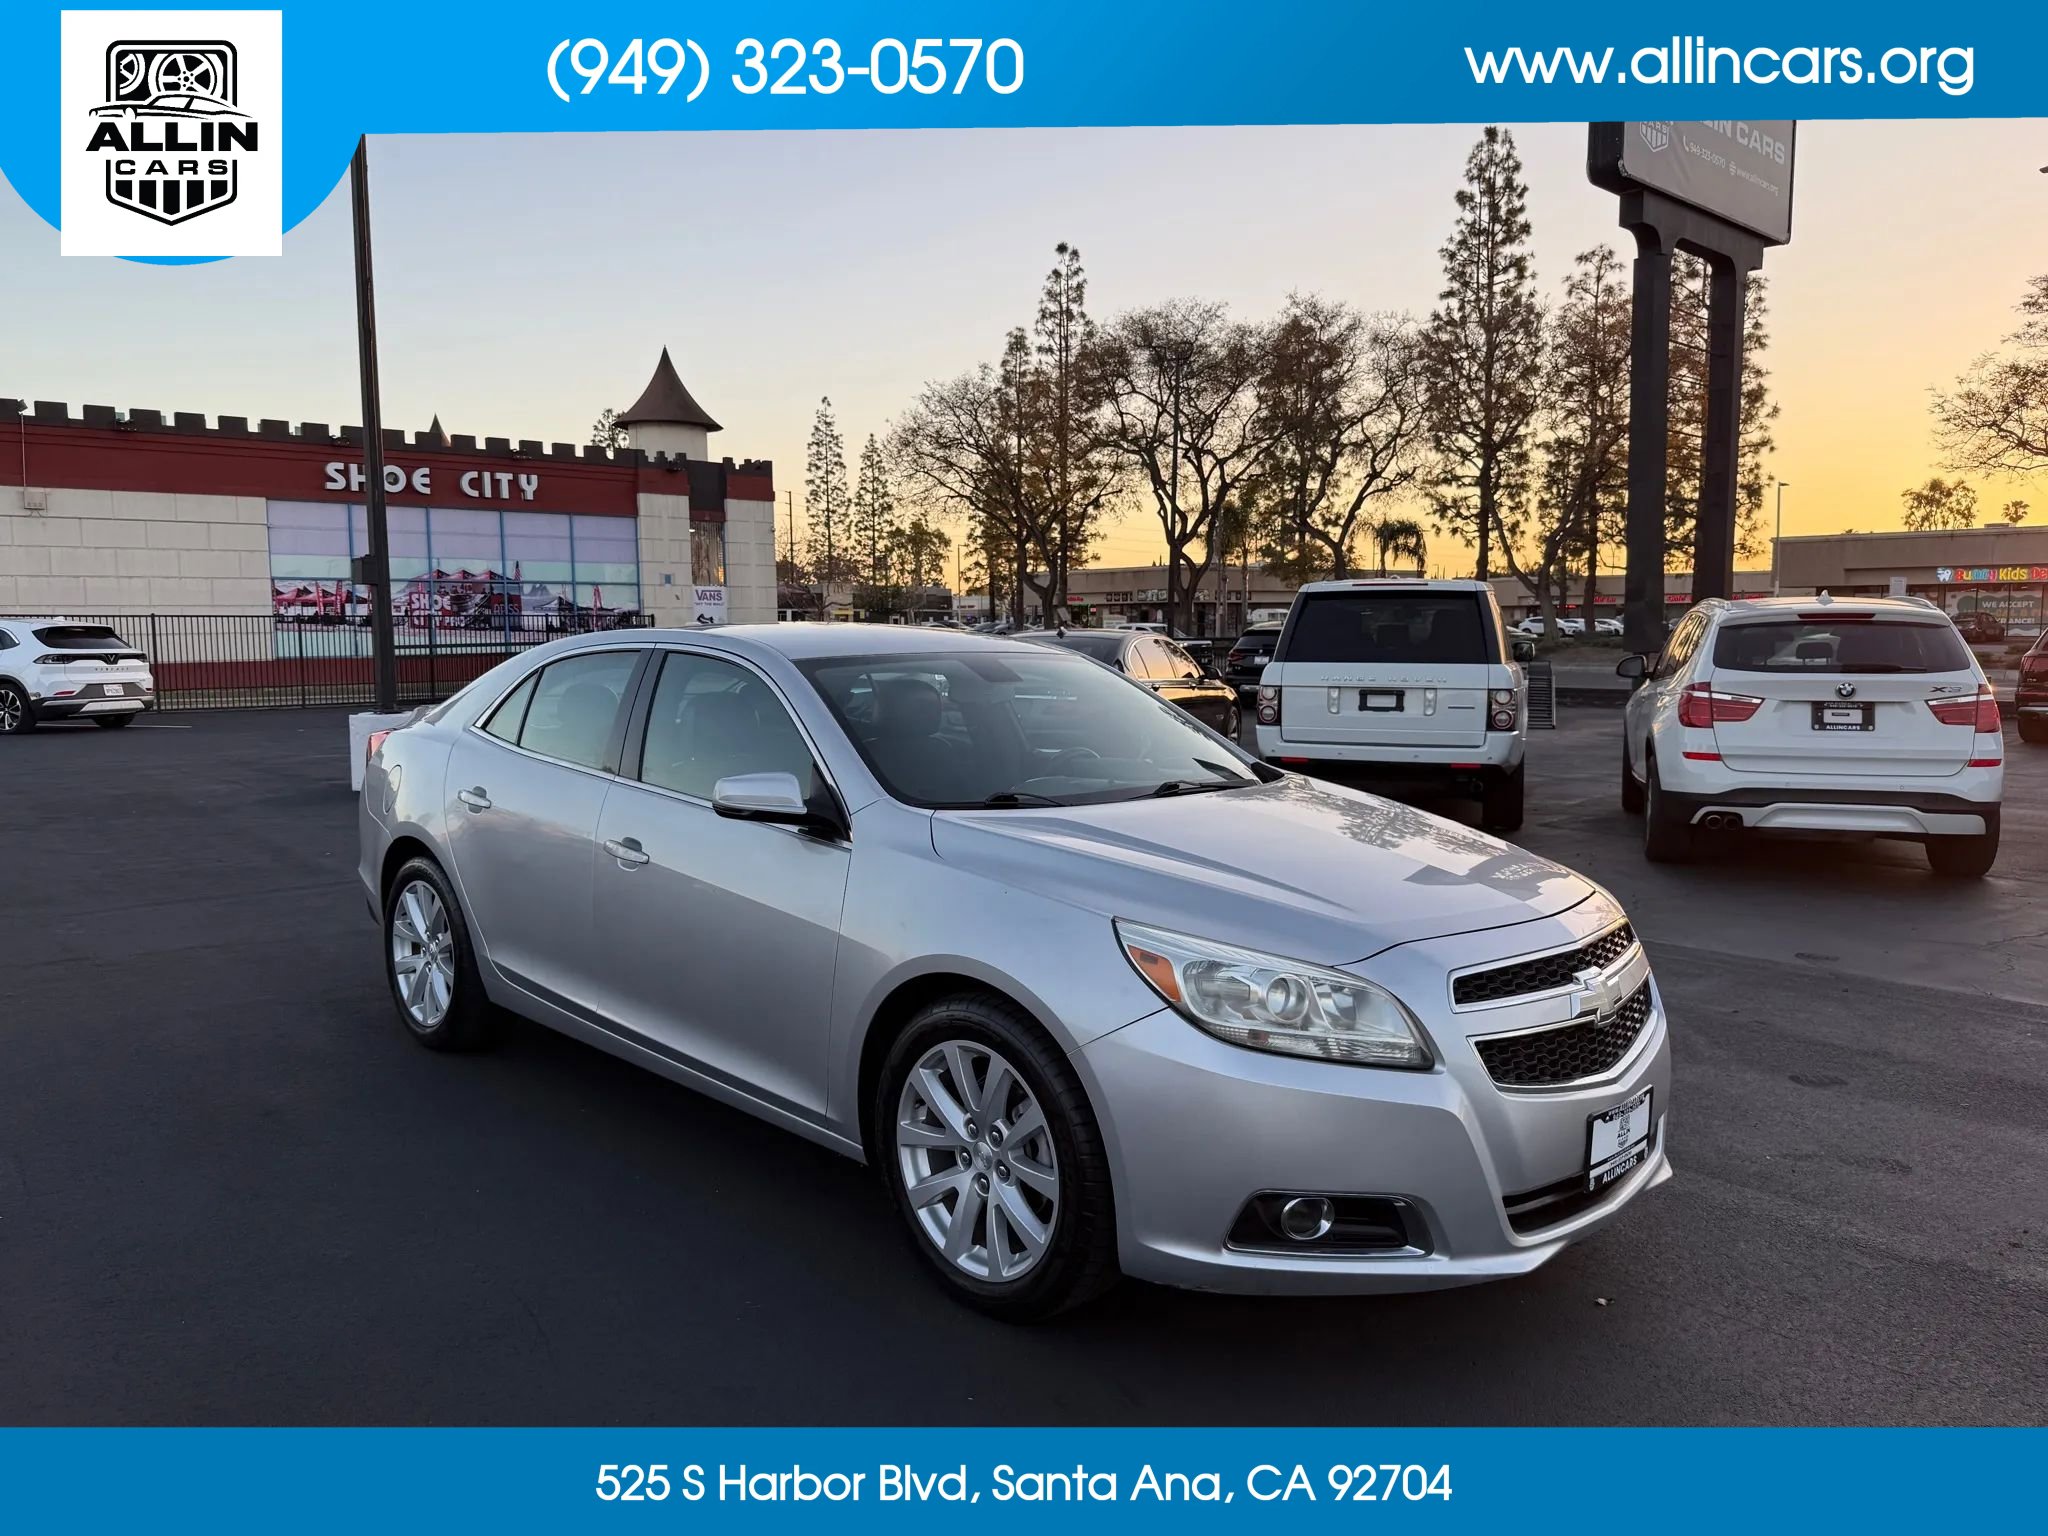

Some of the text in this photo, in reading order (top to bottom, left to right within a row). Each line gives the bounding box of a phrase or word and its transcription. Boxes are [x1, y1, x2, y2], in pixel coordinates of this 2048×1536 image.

[1736, 120, 1785, 165] CARS
[325, 461, 539, 501] SHOE CITY
[1955, 568, 1998, 583] Bunny
[1998, 567, 2028, 581] Kids
[411, 593, 452, 611] SHOE
[695, 589, 723, 601] VANS
[1981, 600, 2035, 609] WE ACCEPT
[1602, 1154, 1638, 1185] ALLINCARS
